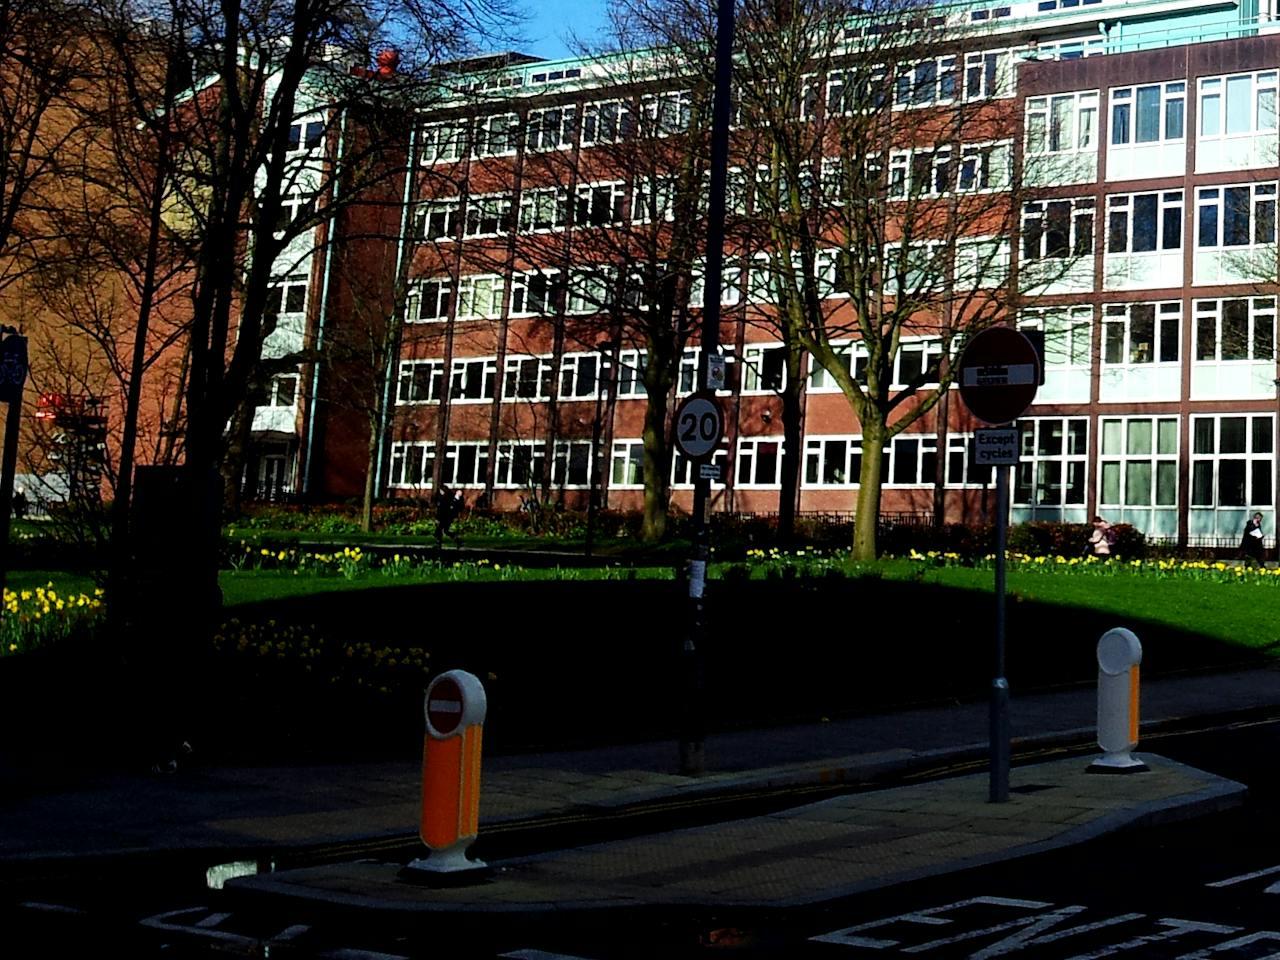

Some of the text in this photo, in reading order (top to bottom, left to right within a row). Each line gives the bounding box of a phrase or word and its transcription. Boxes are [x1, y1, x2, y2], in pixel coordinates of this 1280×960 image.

[681, 412, 717, 441] 20
[979, 433, 1015, 446] Except
[980, 448, 1013, 460] cycles
